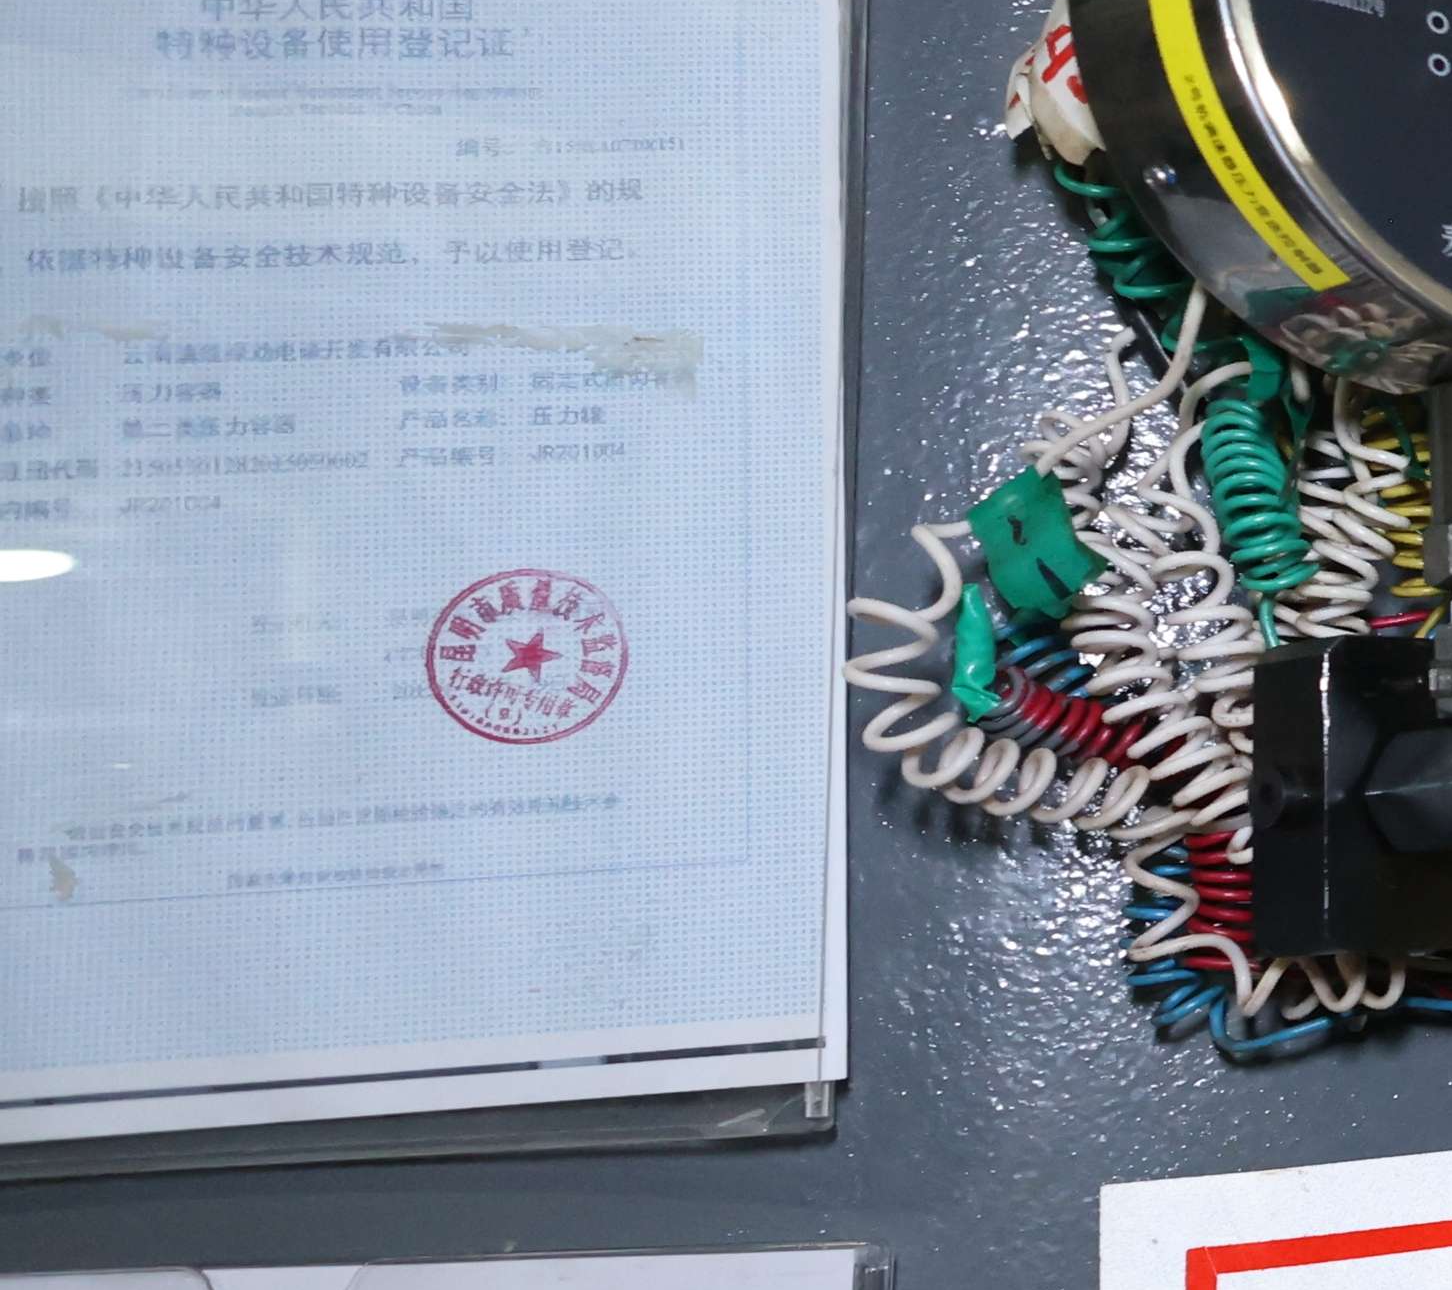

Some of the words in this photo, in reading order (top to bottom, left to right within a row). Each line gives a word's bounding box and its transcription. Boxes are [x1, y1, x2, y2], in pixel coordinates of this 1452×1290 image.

[155, 25, 515, 63] 特种设备使用登记证
